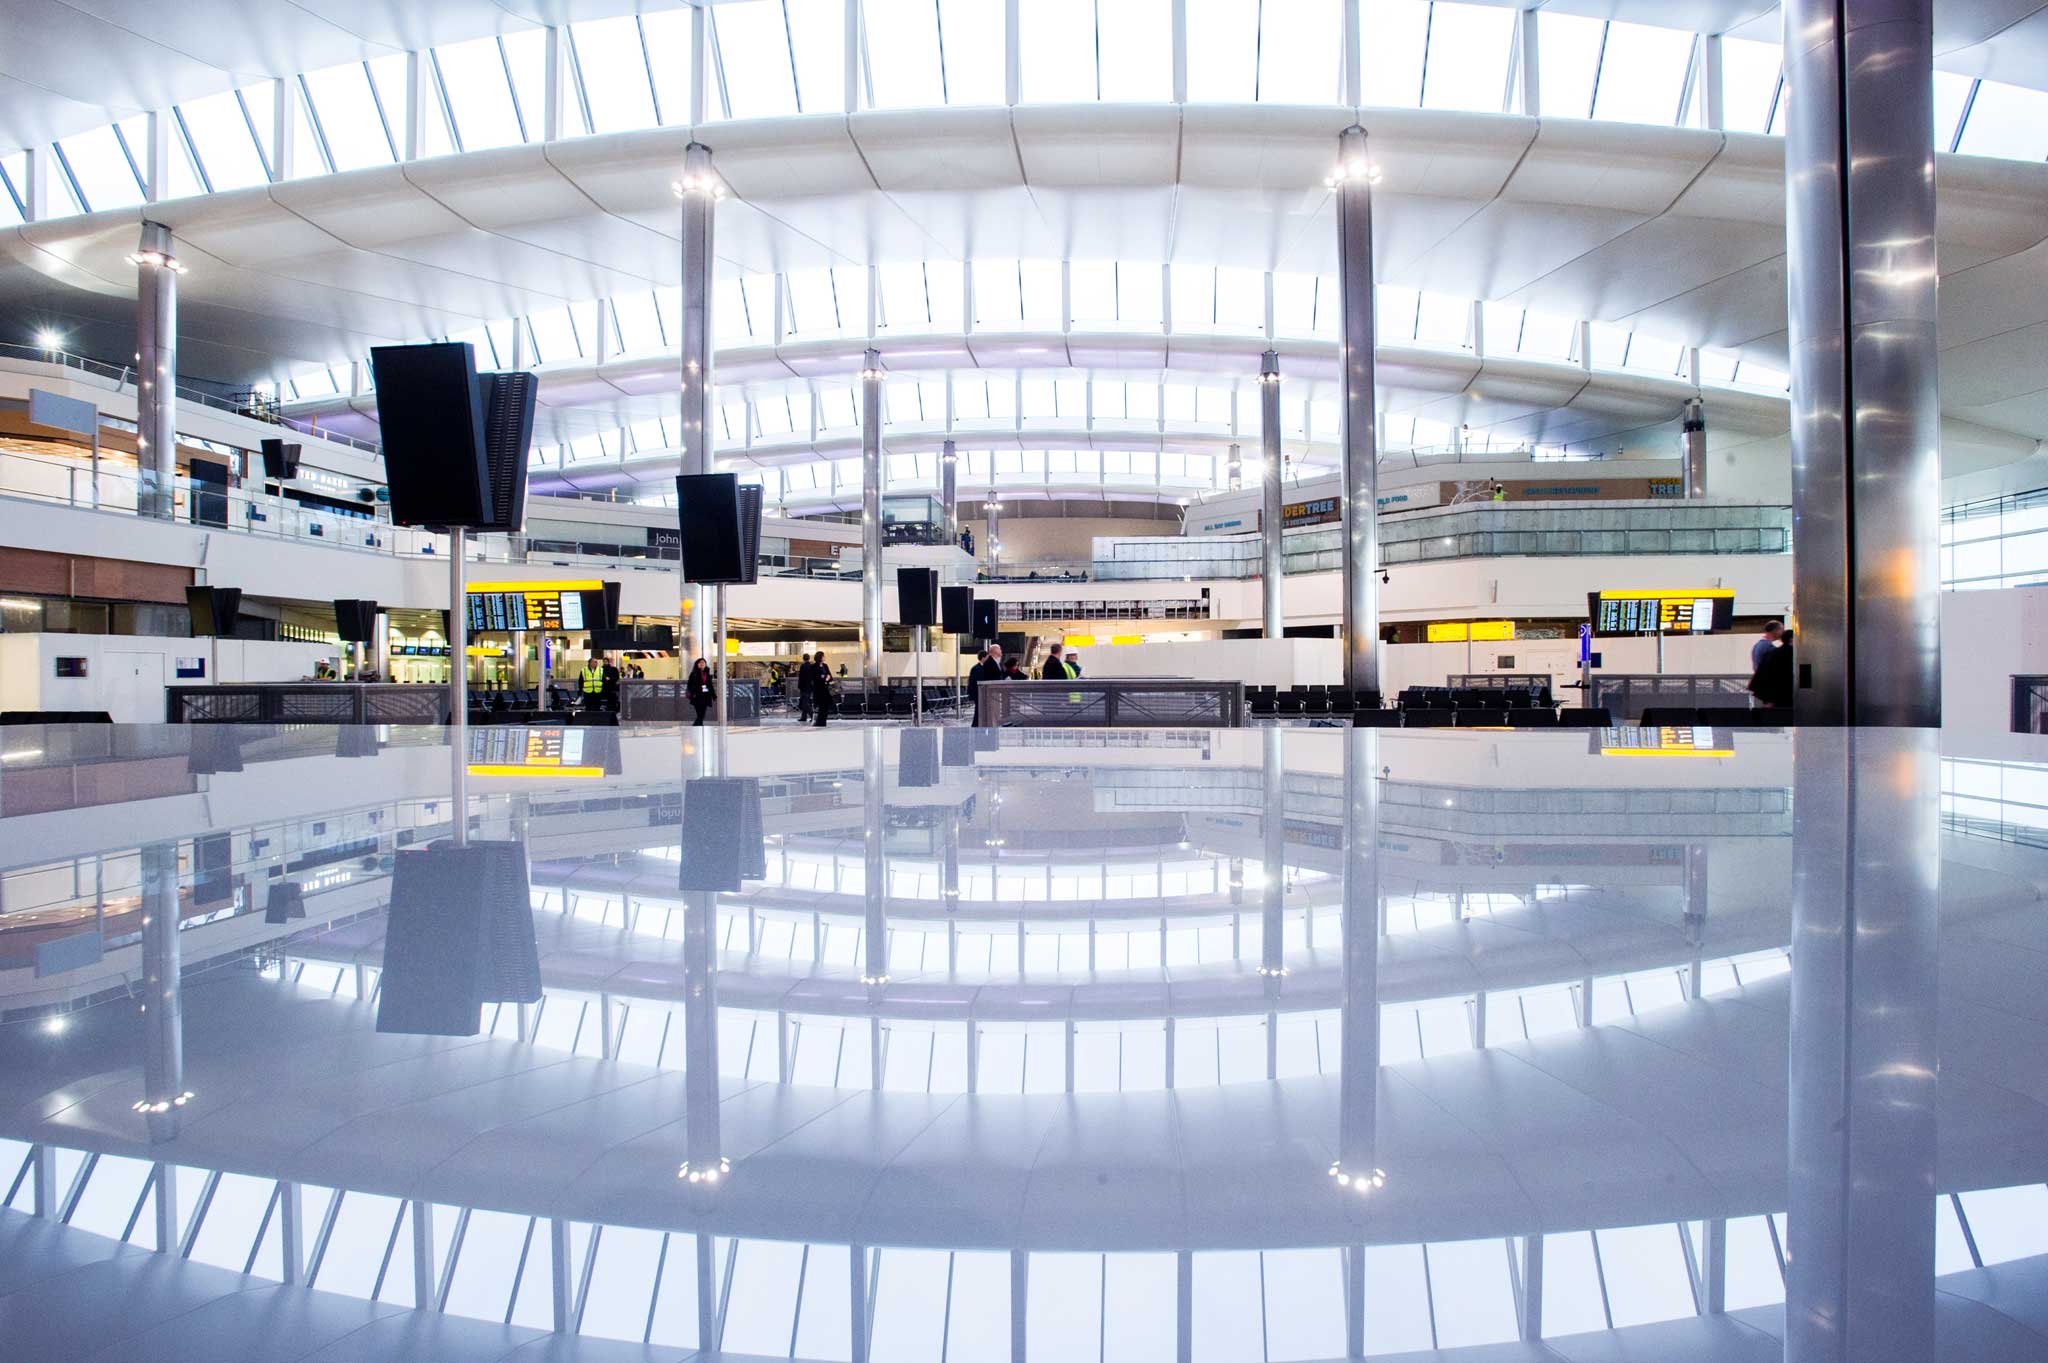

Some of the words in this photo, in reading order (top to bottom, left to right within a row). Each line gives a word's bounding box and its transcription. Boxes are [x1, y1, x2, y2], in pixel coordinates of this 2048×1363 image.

[300, 469, 317, 480] TED
[320, 475, 347, 488] BAKER
[1650, 485, 1681, 495] TREE
[655, 532, 679, 546] John
